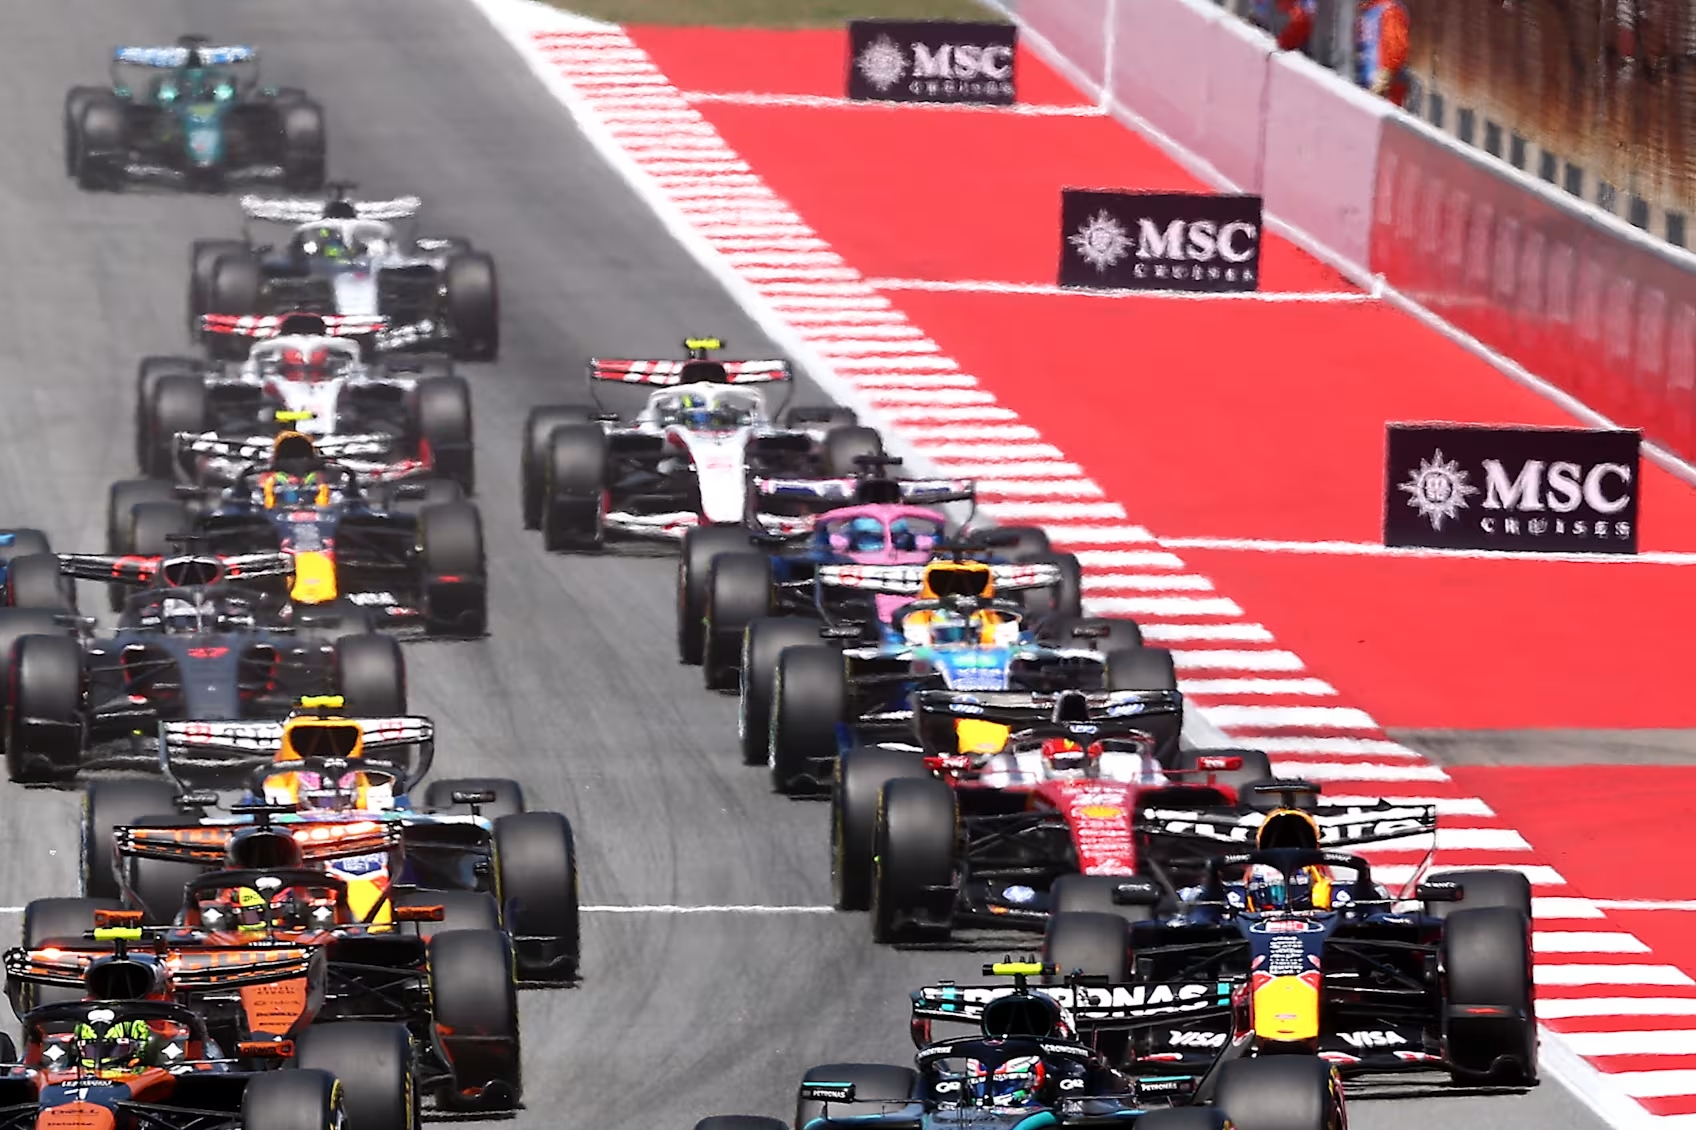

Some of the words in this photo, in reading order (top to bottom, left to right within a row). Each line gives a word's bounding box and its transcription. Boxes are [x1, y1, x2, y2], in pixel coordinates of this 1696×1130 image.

[910, 41, 1013, 80] MSC
[1135, 217, 1257, 263] MSC
[1480, 459, 1631, 514] MSC
[1480, 517, 1631, 540] CRUISES
[1169, 1030, 1227, 1048] VISA
[1336, 1030, 1408, 1048] VISA
[812, 1089, 846, 1099] PETRONAS
